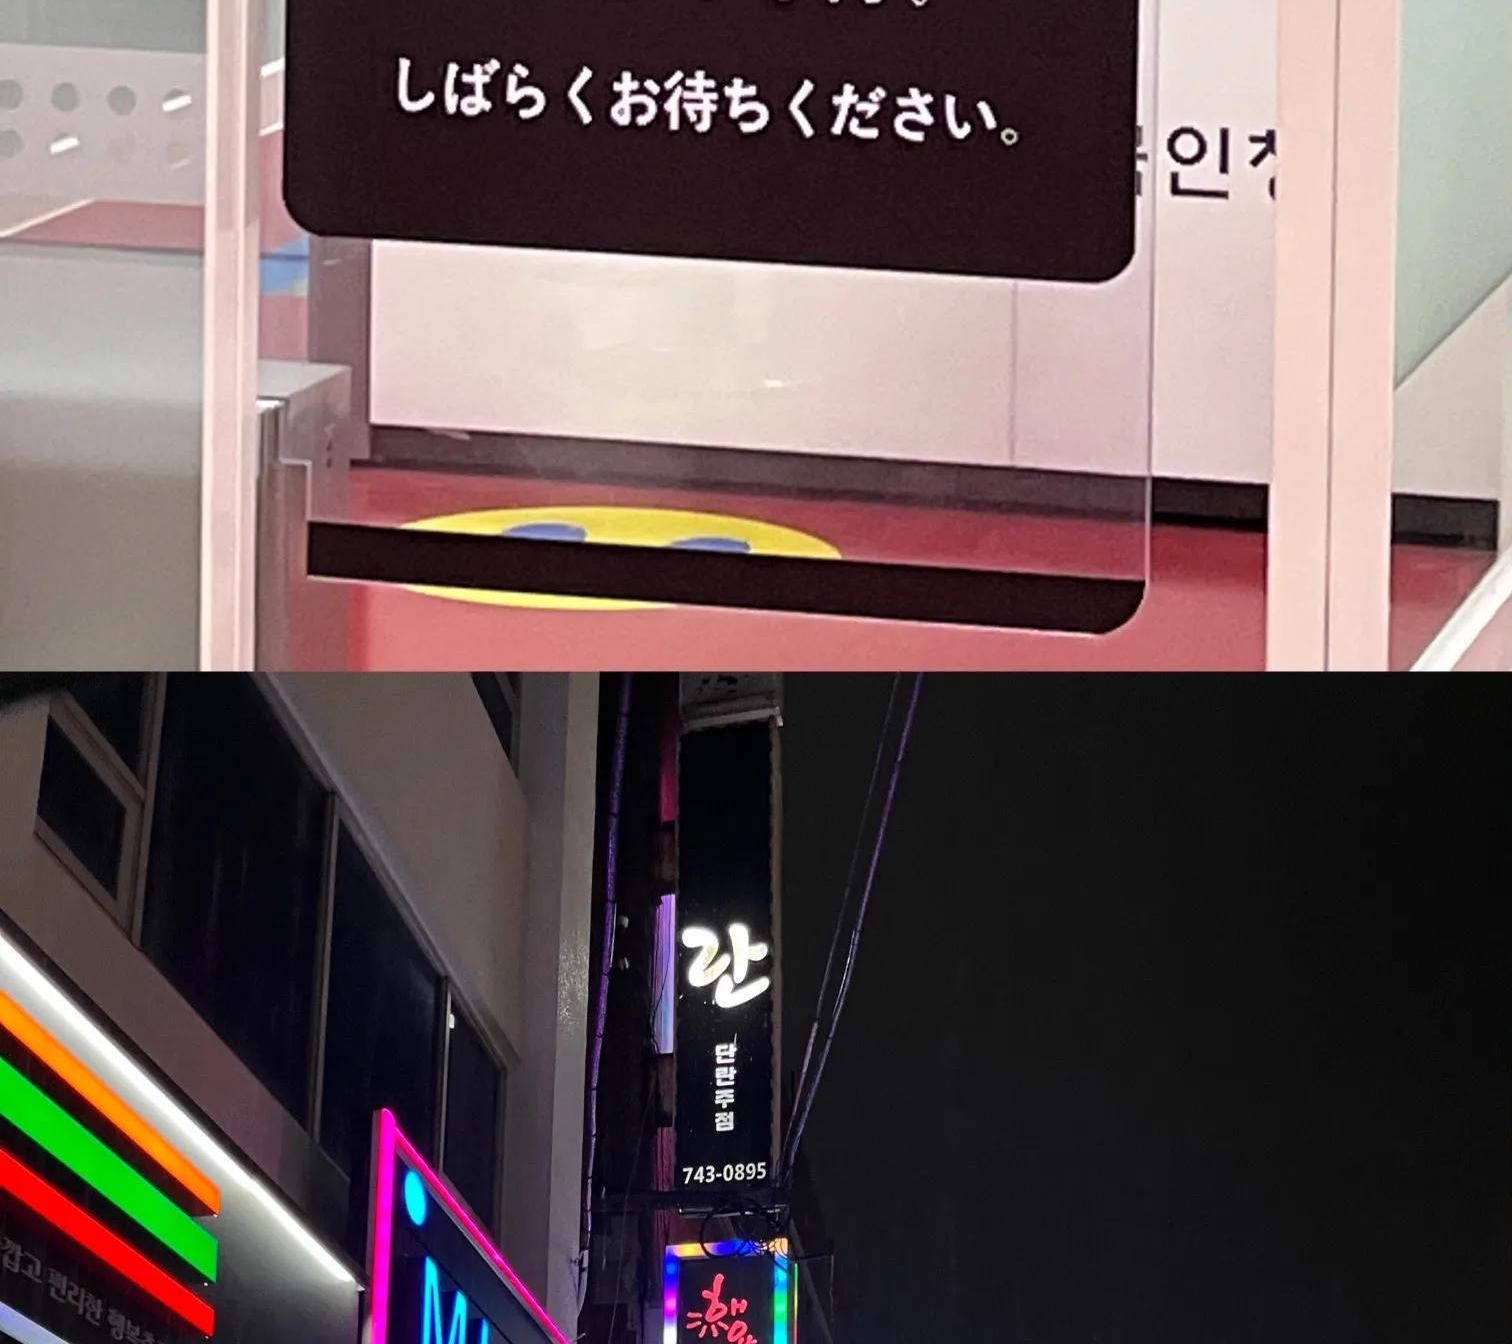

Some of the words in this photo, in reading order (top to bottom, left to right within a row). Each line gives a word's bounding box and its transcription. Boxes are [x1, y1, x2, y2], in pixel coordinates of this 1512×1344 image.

[397, 57, 1017, 145] しばらくお待ちください。
[682, 1162, 767, 1184] 743-0895
